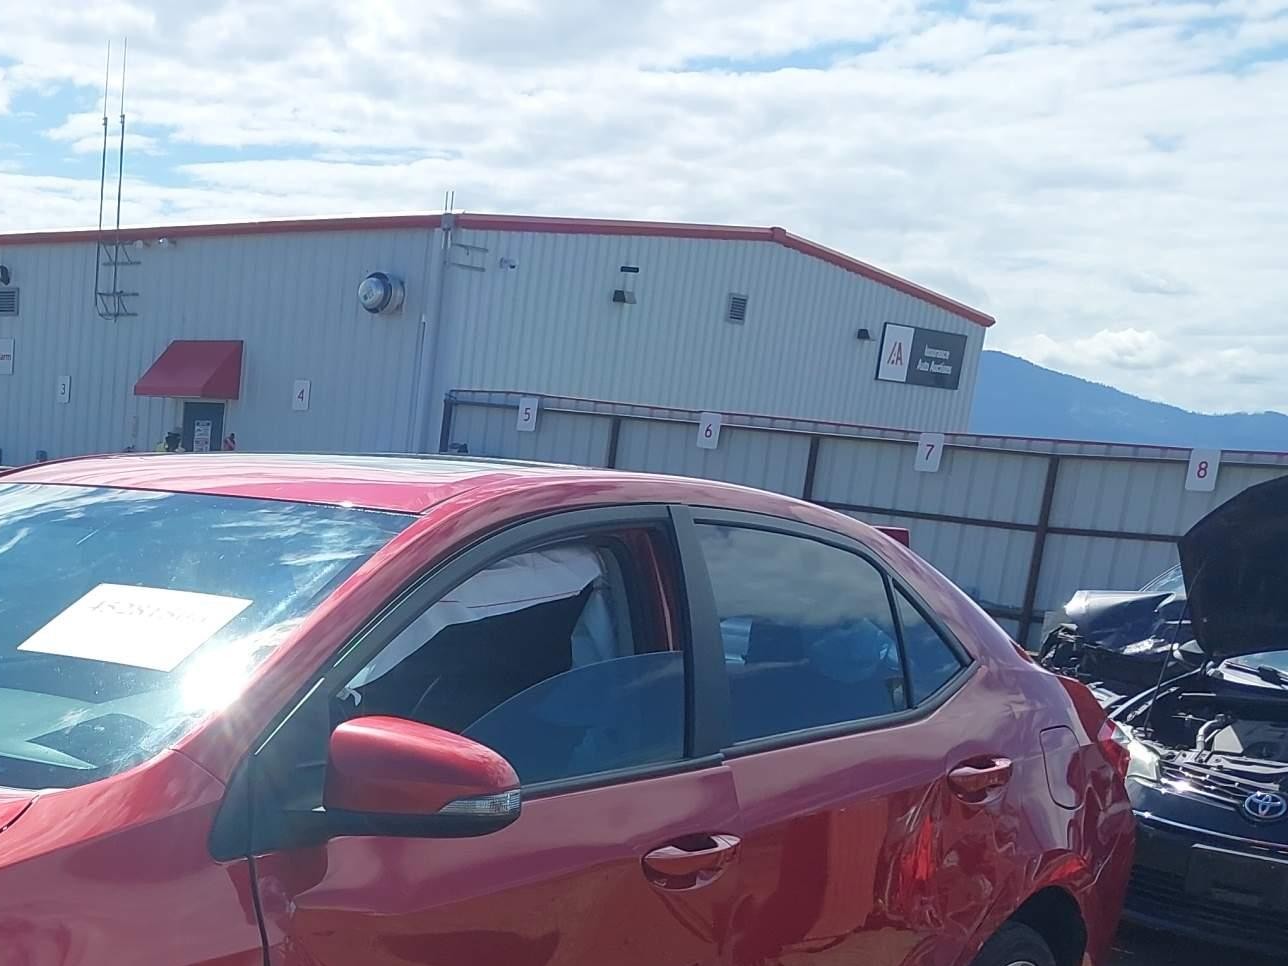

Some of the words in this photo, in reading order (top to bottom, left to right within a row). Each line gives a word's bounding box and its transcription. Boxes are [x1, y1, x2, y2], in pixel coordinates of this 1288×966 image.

[60, 383, 66, 395] 3
[297, 388, 305, 402] 4
[523, 407, 531, 422] 5
[704, 423, 713, 438] 6
[925, 443, 935, 461] 7
[1196, 460, 1208, 478] 8
